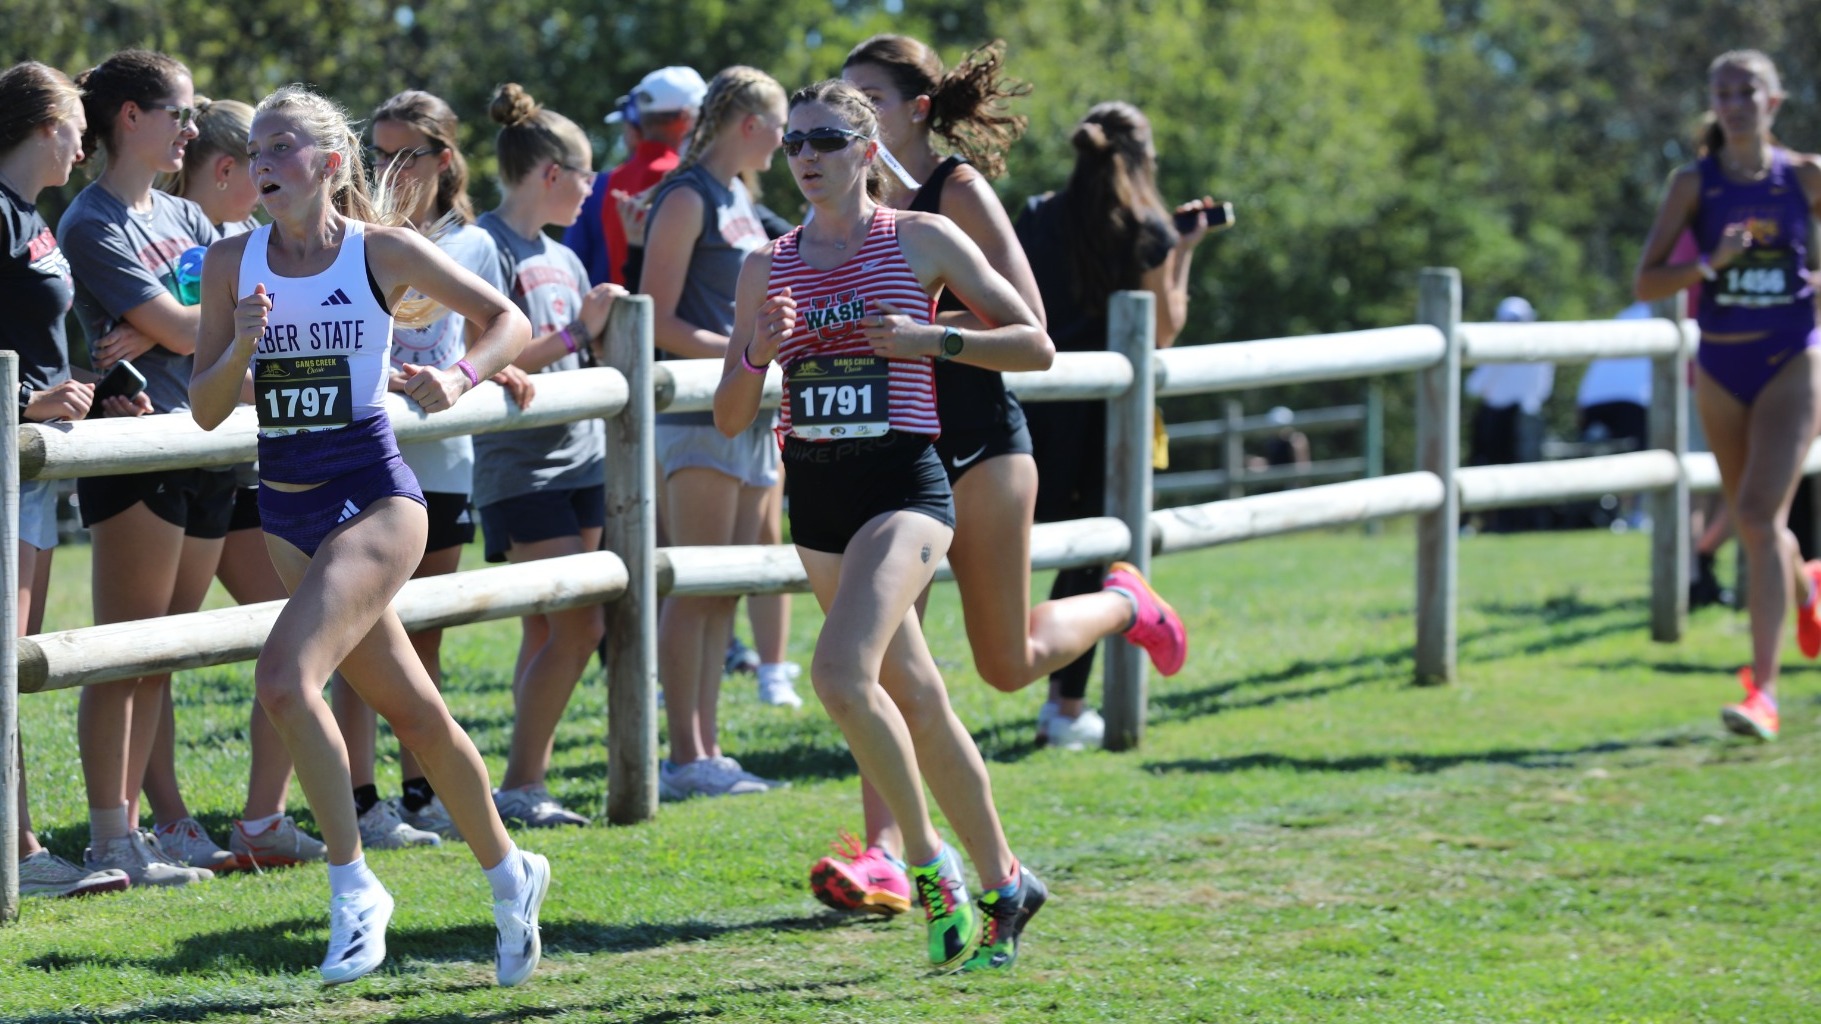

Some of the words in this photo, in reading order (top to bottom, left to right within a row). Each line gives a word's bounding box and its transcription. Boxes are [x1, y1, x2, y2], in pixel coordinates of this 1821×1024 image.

[804, 299, 866, 331] WASH
[309, 319, 365, 350] STATE
[295, 359, 315, 369] GANS
[315, 357, 337, 367] CREEK
[854, 357, 875, 366] CREEK
[264, 386, 339, 419] 1797
[800, 384, 872, 417] 1791
[785, 442, 830, 463] NIKE
[835, 433, 898, 462] PRO
